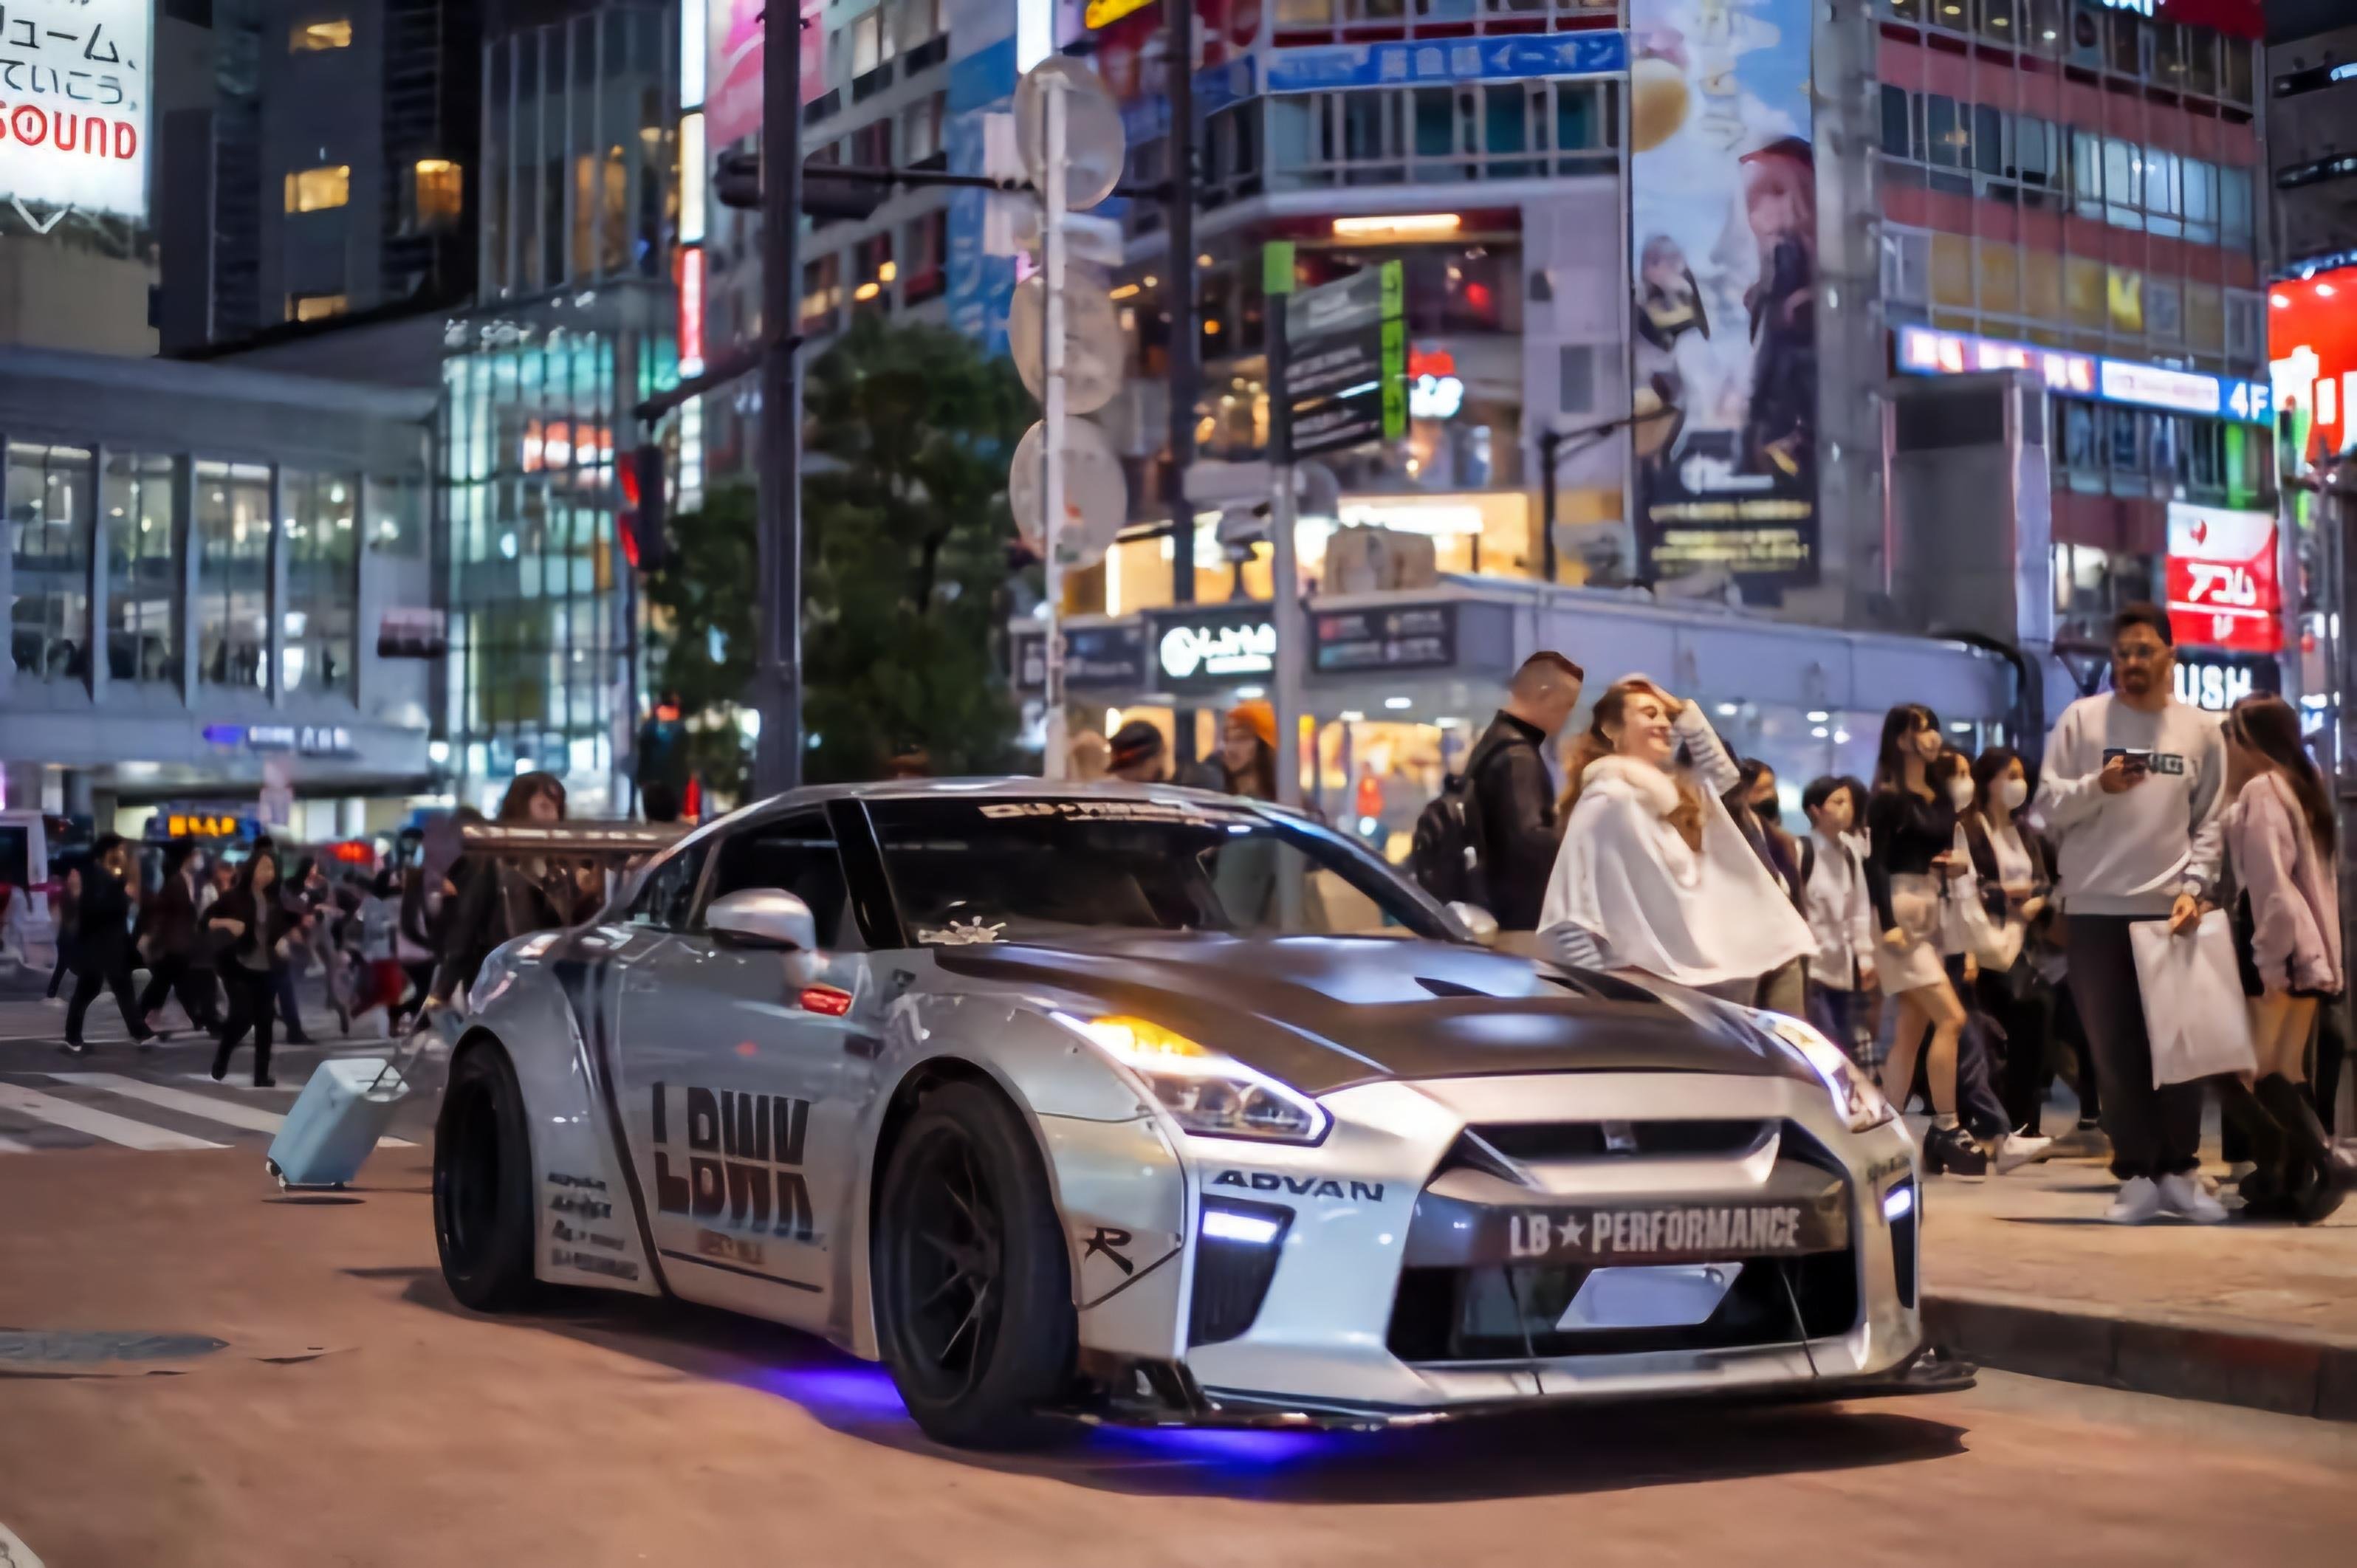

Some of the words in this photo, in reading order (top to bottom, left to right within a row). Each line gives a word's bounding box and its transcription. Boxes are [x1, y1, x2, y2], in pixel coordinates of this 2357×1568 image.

[0, 4, 137, 71] ューム、
[0, 100, 137, 160] OUND
[2229, 381, 2270, 420] 4F
[2186, 563, 2257, 606] アコム
[2173, 662, 2252, 711] USH
[652, 1082, 817, 1242] LBWK
[1212, 1169, 1385, 1203] ADVAN
[1509, 1214, 1551, 1256] LB
[1592, 1206, 1801, 1253] PERFORMANCE
